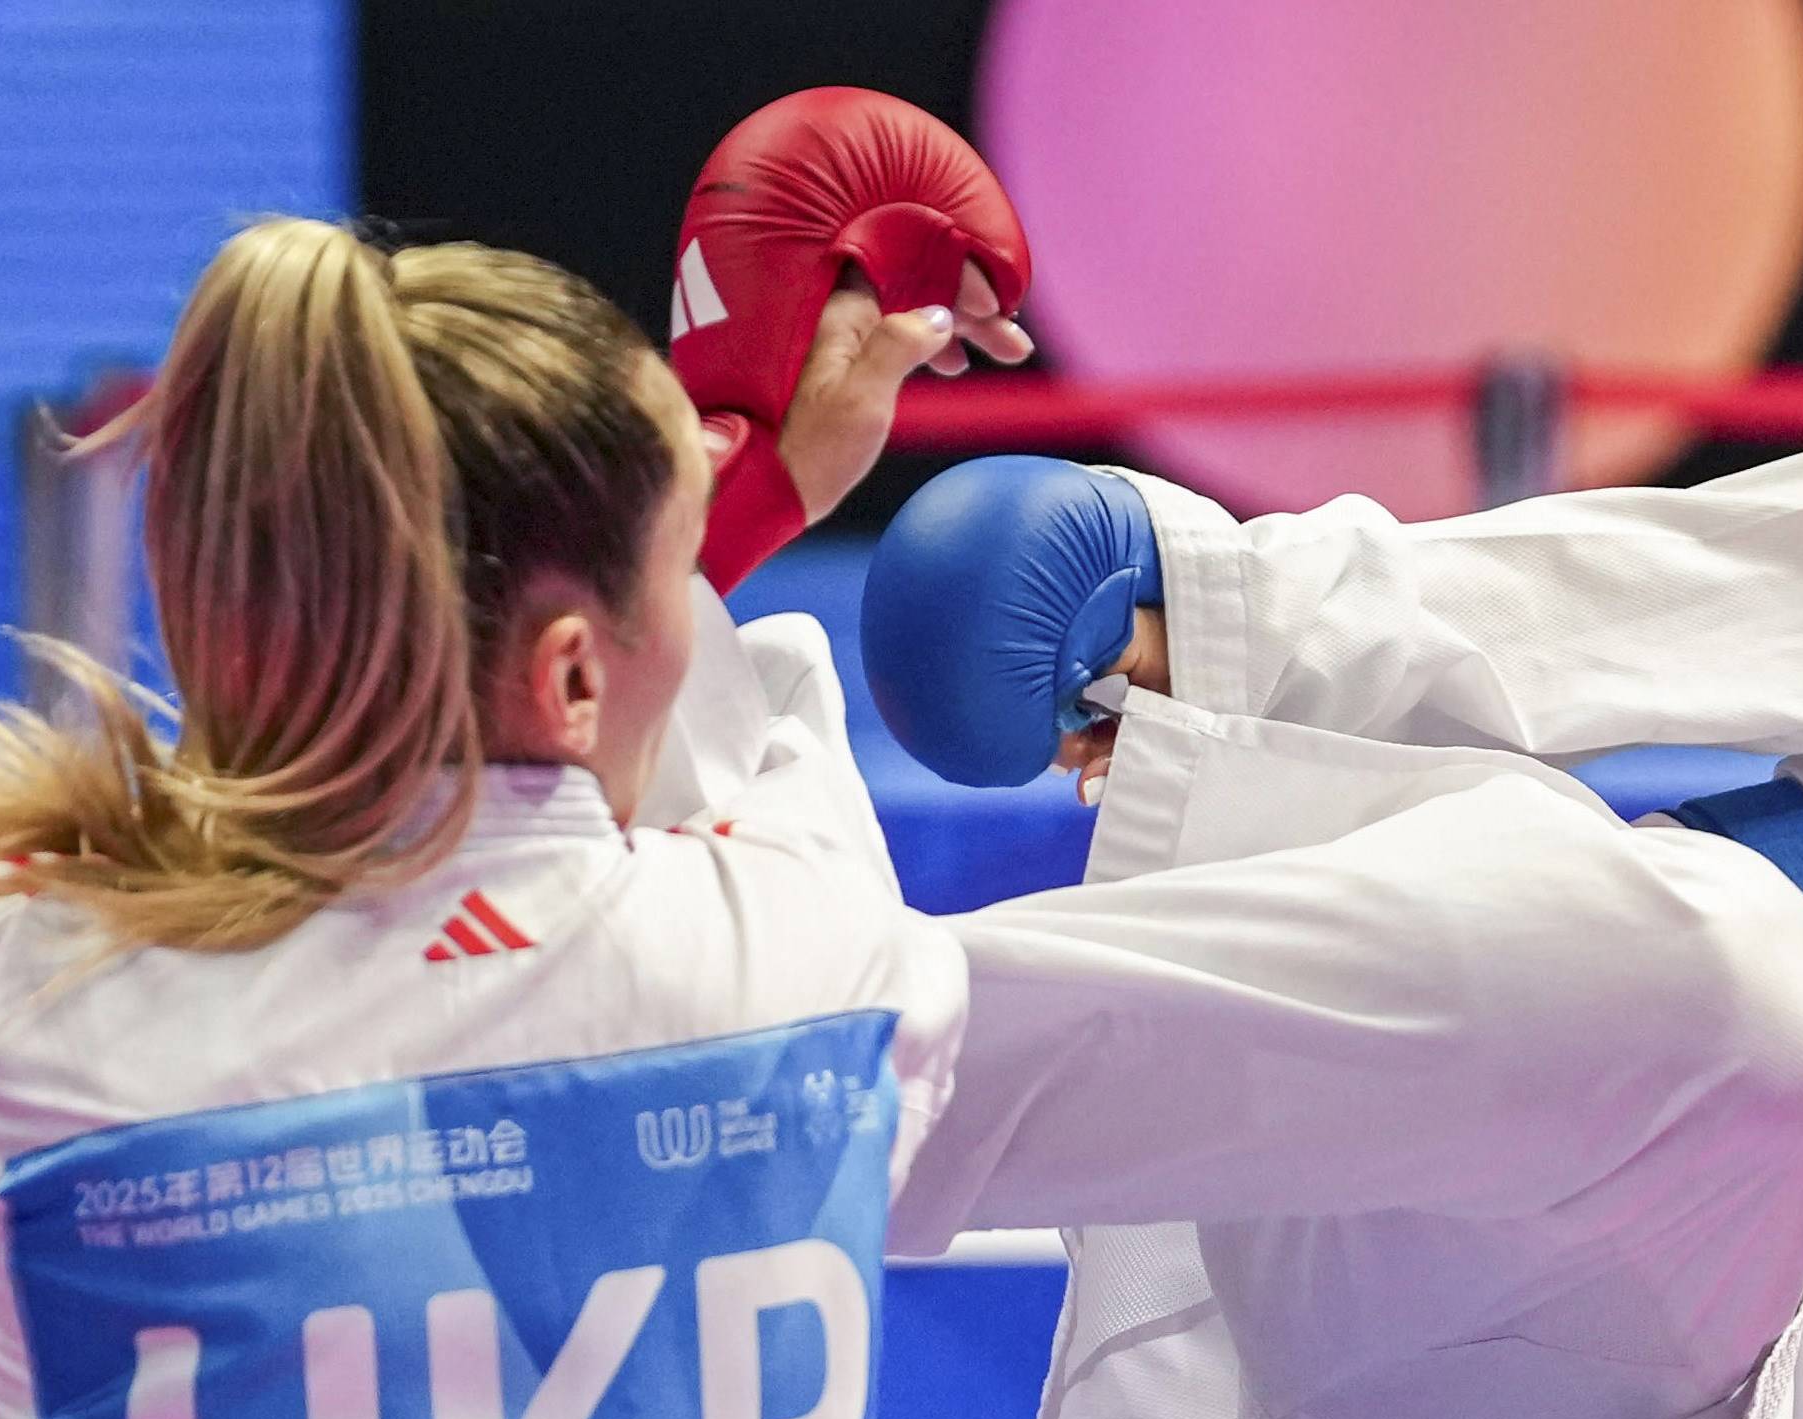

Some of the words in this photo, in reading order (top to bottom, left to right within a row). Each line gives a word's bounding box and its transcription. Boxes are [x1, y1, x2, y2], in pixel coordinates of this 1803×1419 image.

[132, 1209, 228, 1247] WORLD
[232, 1192, 331, 1231] GAMES
[403, 1165, 534, 1205] CHENGDU
